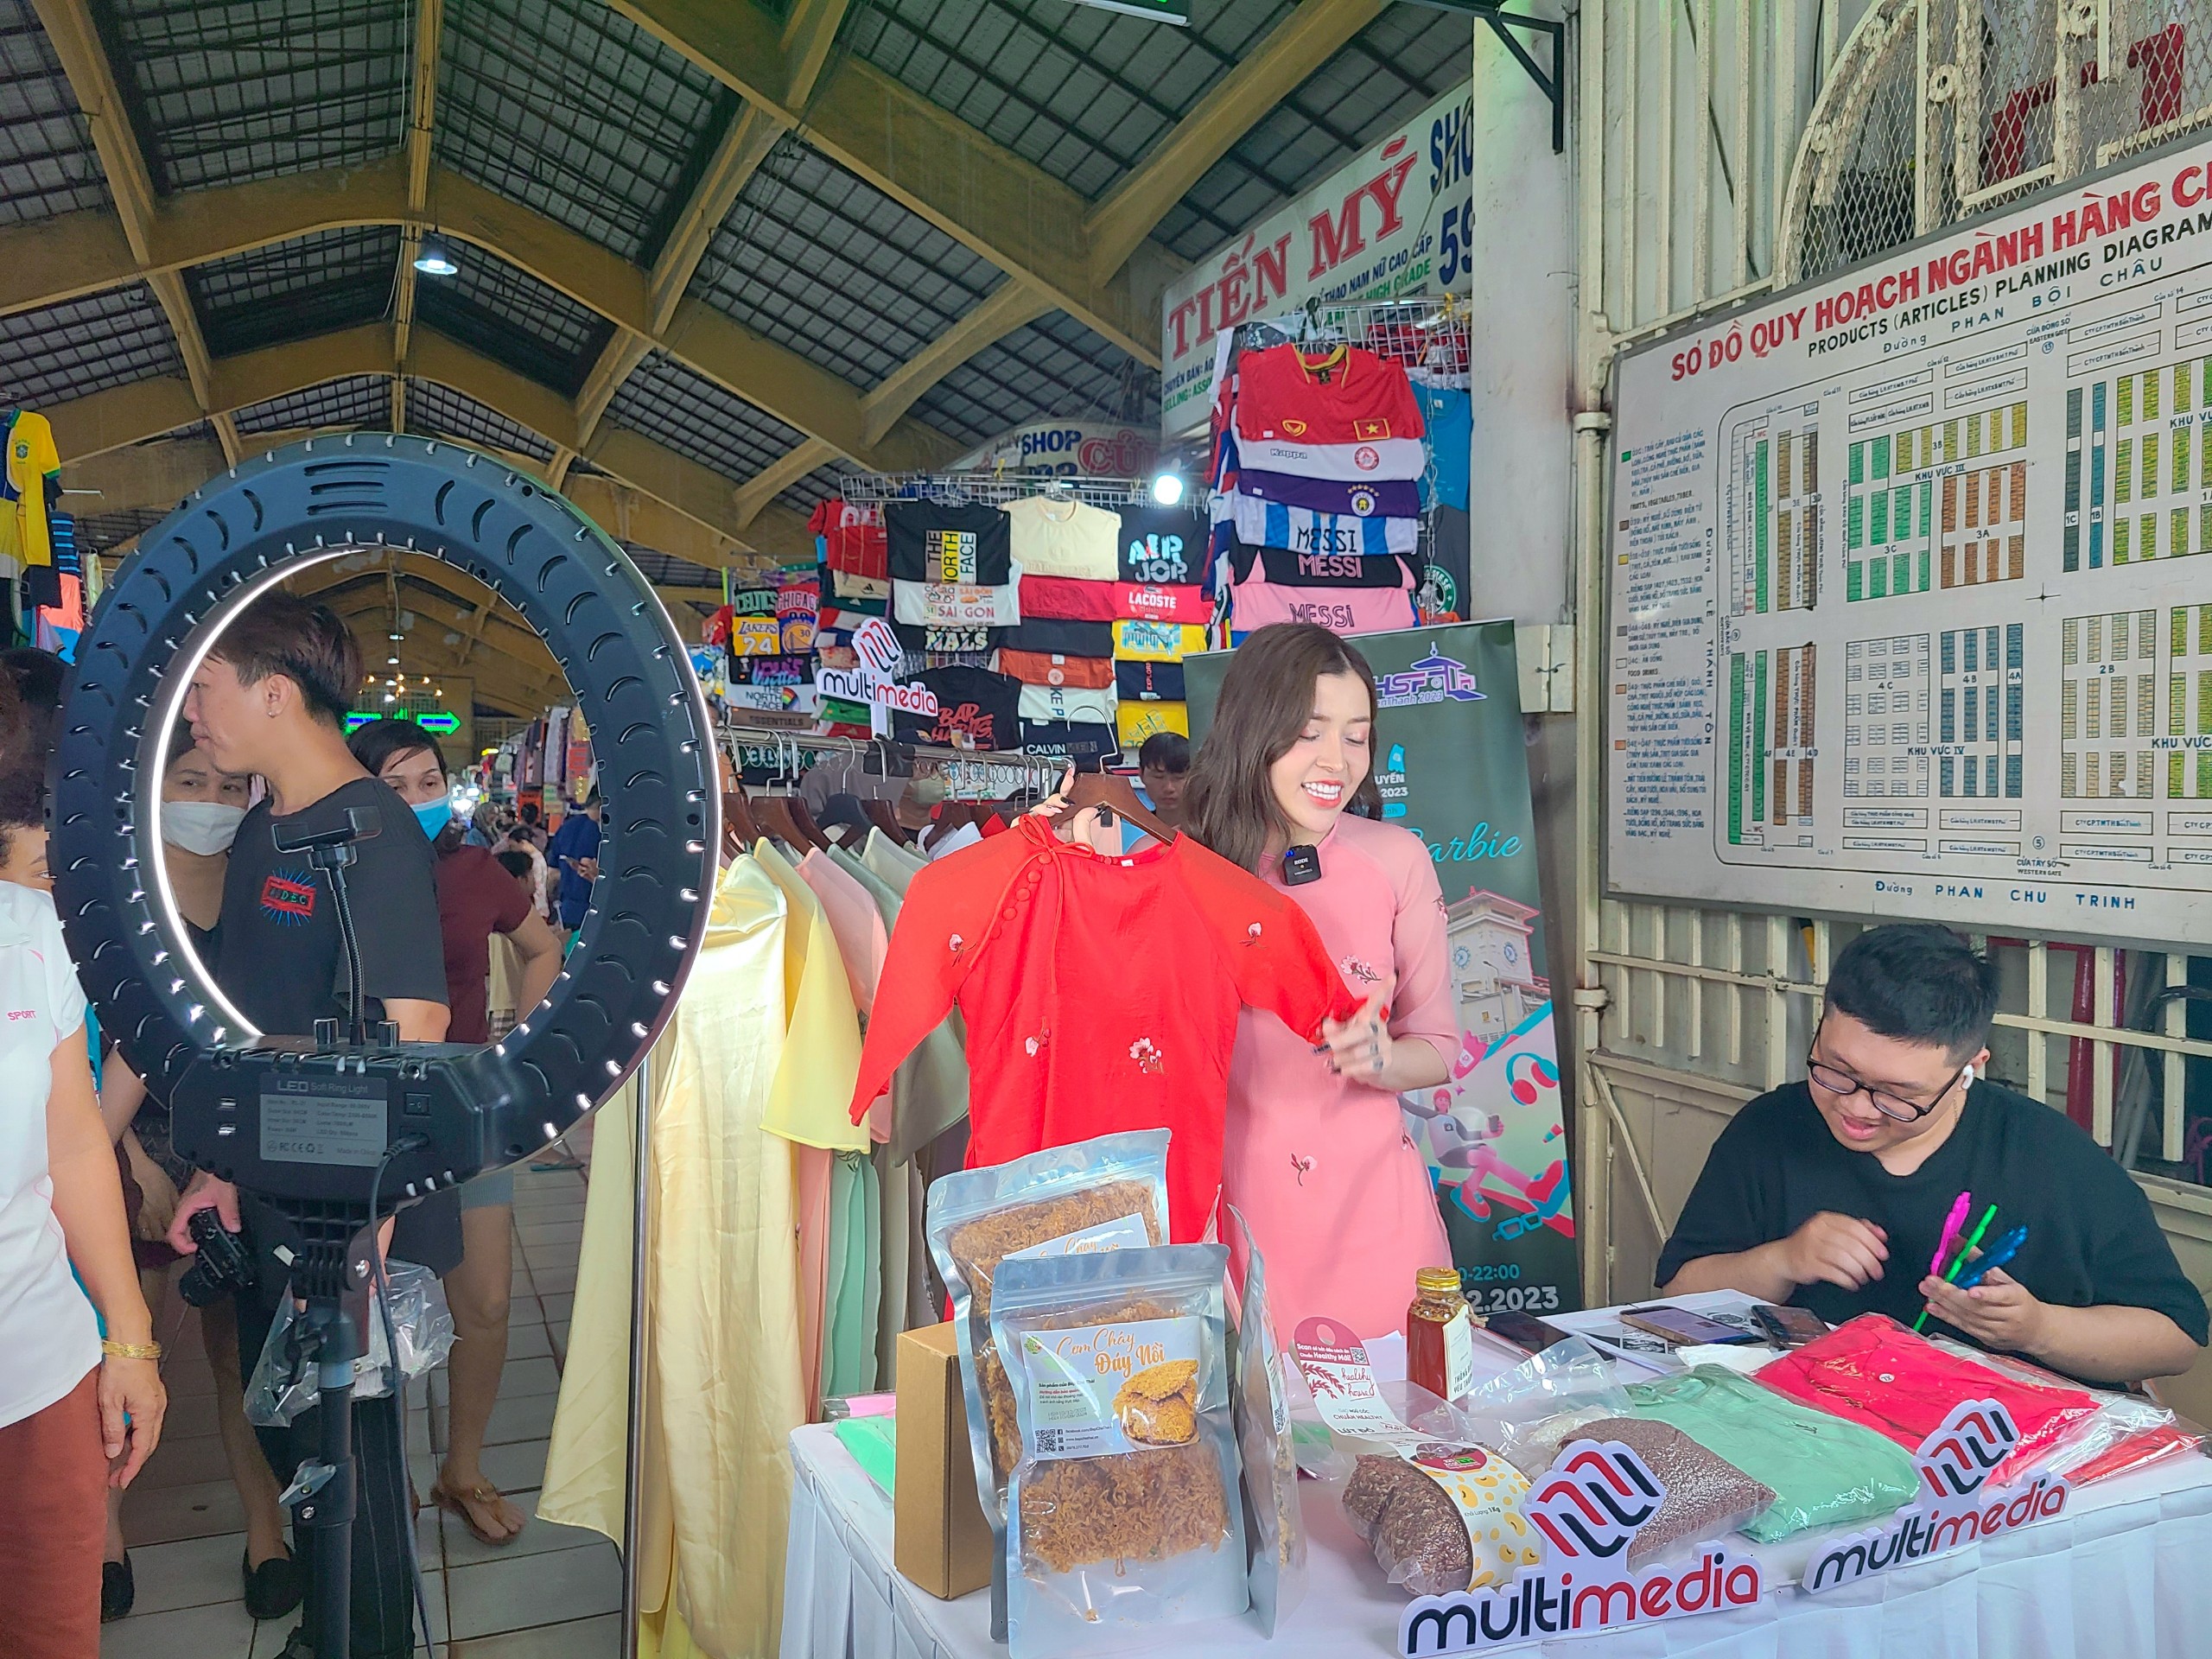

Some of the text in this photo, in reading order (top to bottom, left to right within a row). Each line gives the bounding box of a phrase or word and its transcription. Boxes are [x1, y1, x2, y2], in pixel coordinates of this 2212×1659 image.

[1168, 135, 1418, 360] TIẾN MỸ
[1350, 270, 1370, 294] NAM
[1389, 249, 1408, 272] CAO
[1708, 319, 1744, 369] ĐỒ
[1749, 307, 1808, 359] QUY
[1815, 266, 1920, 333] HOẠCH
[1927, 232, 2044, 295] NGÀNH
[2052, 181, 2162, 252] HÀNG
[2171, 161, 2212, 208] C
[1808, 317, 1888, 358] PRODUCTS
[1893, 284, 1988, 332] (ARTICLES)
[1996, 251, 2091, 298] PLANNING
[1883, 257, 2163, 353] Đường PHAN BỘI CHÂU
[2170, 414, 2194, 429] KHU
[1021, 429, 1082, 456] SHOP
[1270, 448, 1307, 460] Kappa
[1915, 470, 1934, 481] KHU
[1297, 525, 1357, 553] MESSI
[1976, 529, 1990, 539] 3A
[927, 531, 942, 563] THE
[960, 534, 975, 575] FACE
[1885, 544, 1897, 553] 3C
[1298, 554, 1363, 579] MESSI
[736, 590, 778, 614] CELTICS
[1128, 591, 1177, 609] LACOSTE
[739, 621, 778, 635] LAKERS
[799, 629, 811, 638] 30
[1706, 639, 1716, 688] THÁNH
[2099, 664, 2115, 675] 2B
[1963, 675, 1978, 683] 4B
[2008, 671, 2022, 681] 4A
[746, 691, 783, 702] NORTH
[823, 671, 937, 714] multimedia
[1418, 690, 1444, 703] 2023
[756, 701, 782, 710] FACE
[938, 702, 980, 727] BAD
[1704, 713, 1714, 745] TÔN
[1027, 743, 1066, 754] CALVIN
[2152, 736, 2180, 749] KHU
[1907, 747, 1928, 756] KHU
[1382, 786, 1408, 798] 2023
[1875, 880, 2135, 909] Đường PHAN CHU TRINH
[7, 1010, 36, 1020] SPORT
[277, 1080, 368, 1095] LED Soft Ring Light
[1093, 1327, 1136, 1353] Cháy
[1094, 1342, 1166, 1378] Đáy Nồi
[1313, 1351, 1337, 1361] Healthy
[1348, 1382, 1370, 1397] house
[1813, 1478, 2066, 1590] multimedia
[1407, 1552, 1758, 1655] multimedia
